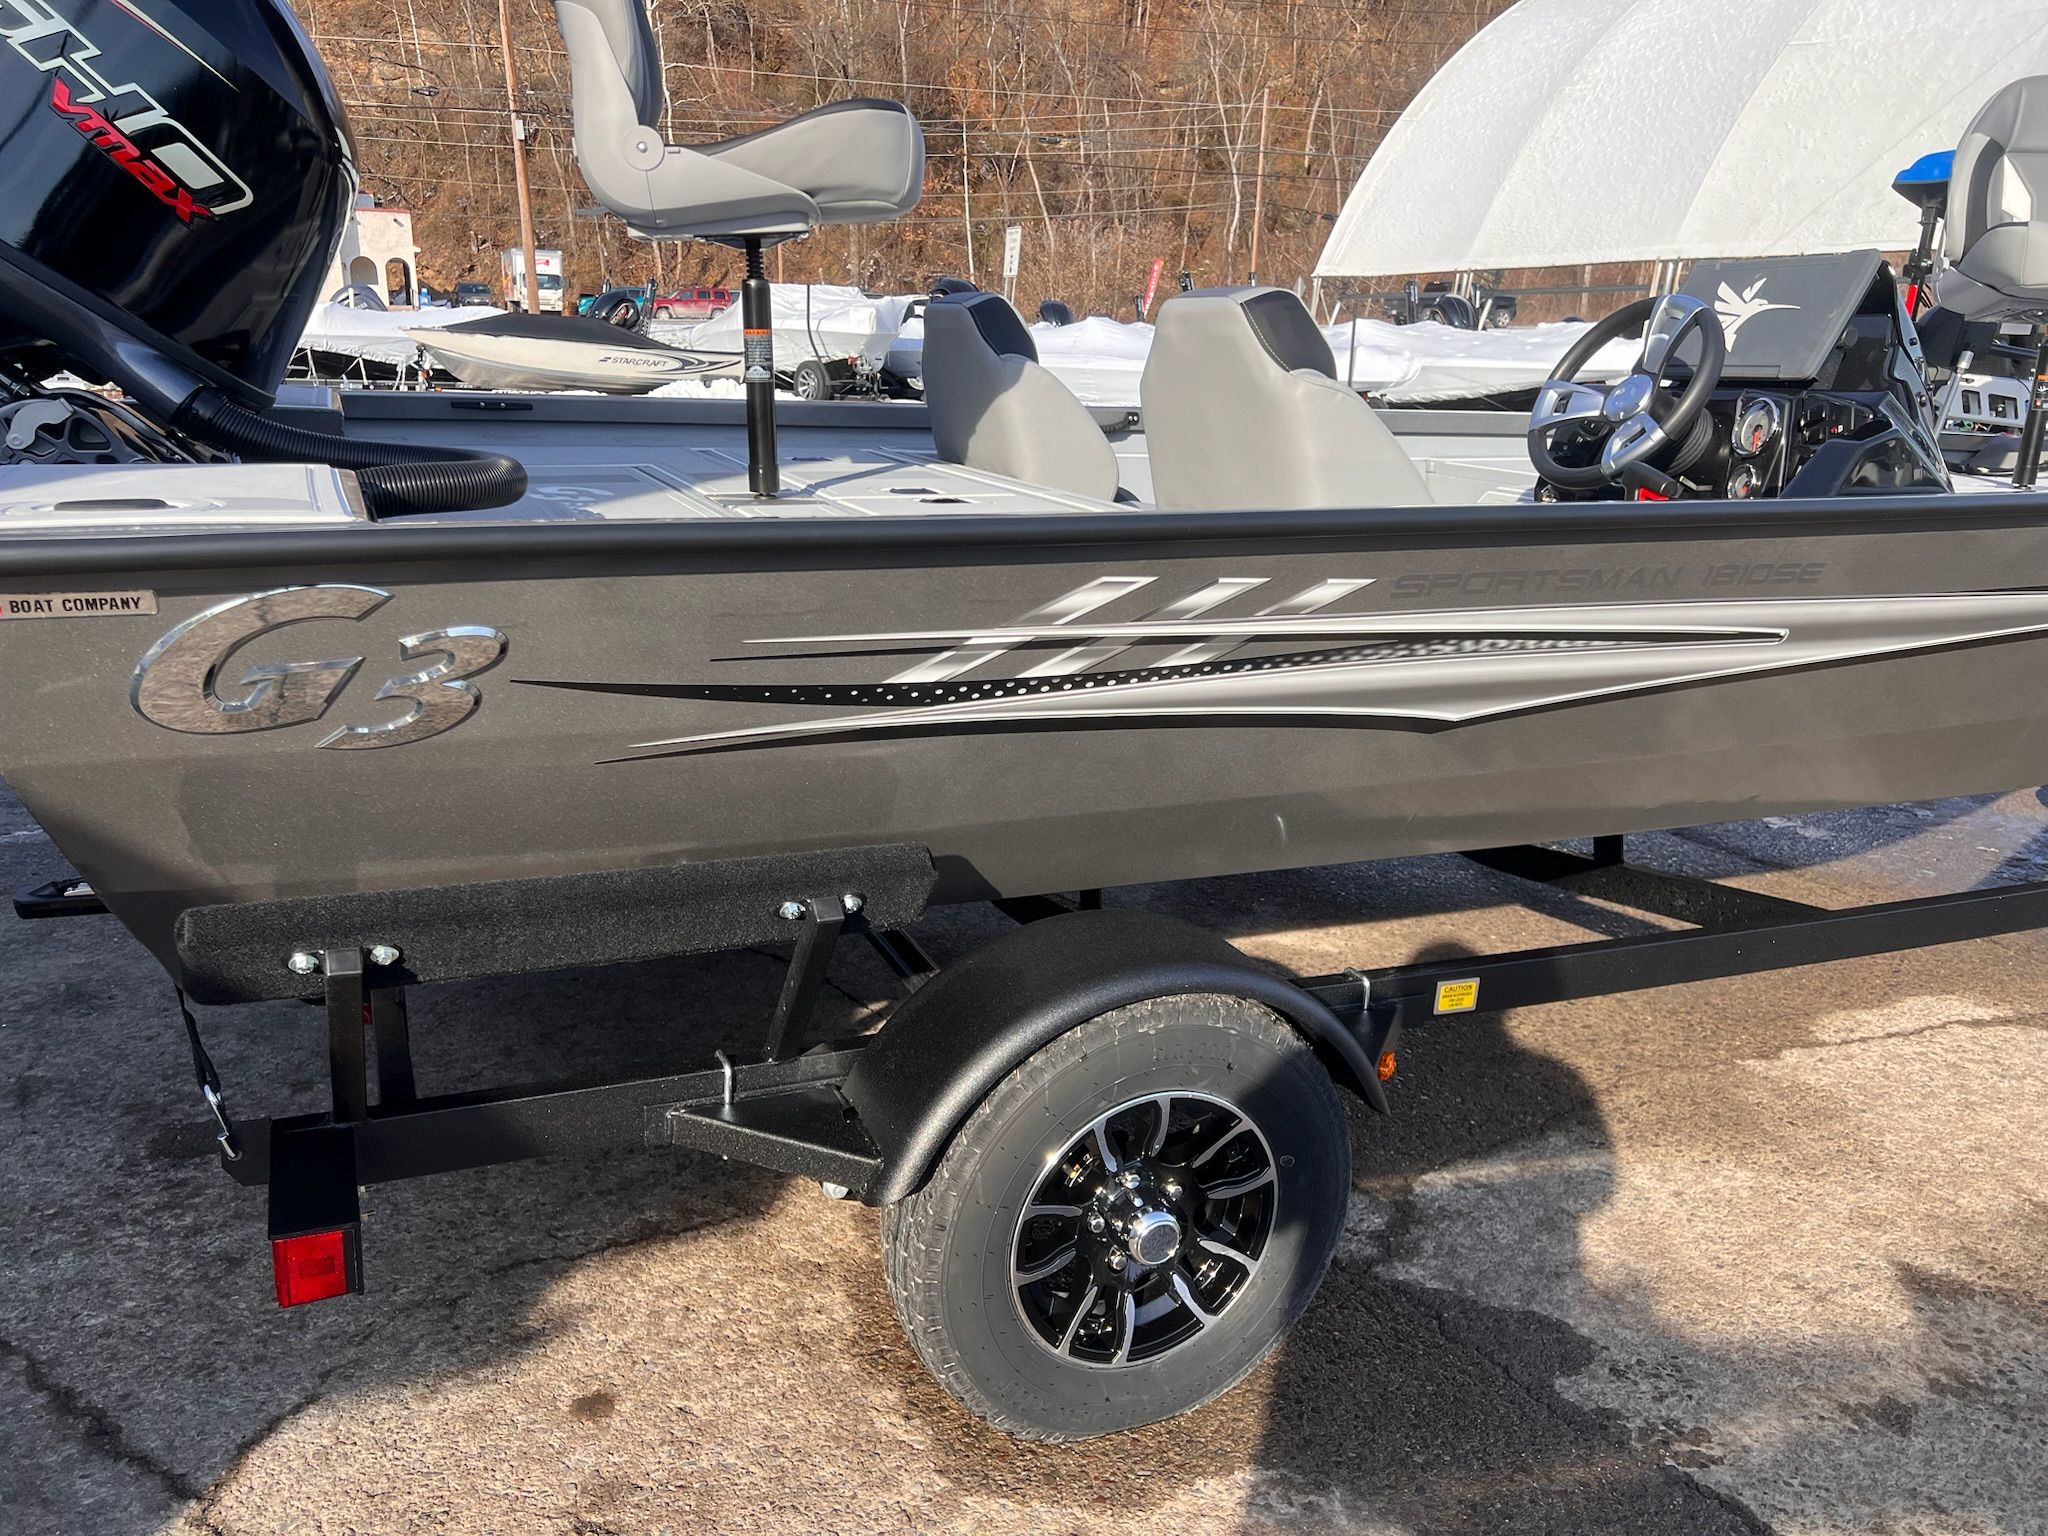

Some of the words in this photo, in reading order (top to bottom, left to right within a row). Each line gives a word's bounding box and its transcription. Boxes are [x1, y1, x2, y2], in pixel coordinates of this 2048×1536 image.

[610, 356, 669, 368] STARCRAFT
[1390, 565, 1688, 599] SPORTSMAN
[10, 599, 53, 614] BOAT
[62, 596, 142, 612] COMPANY
[129, 583, 510, 751] G3
[1444, 984, 1473, 993] CAUTION
